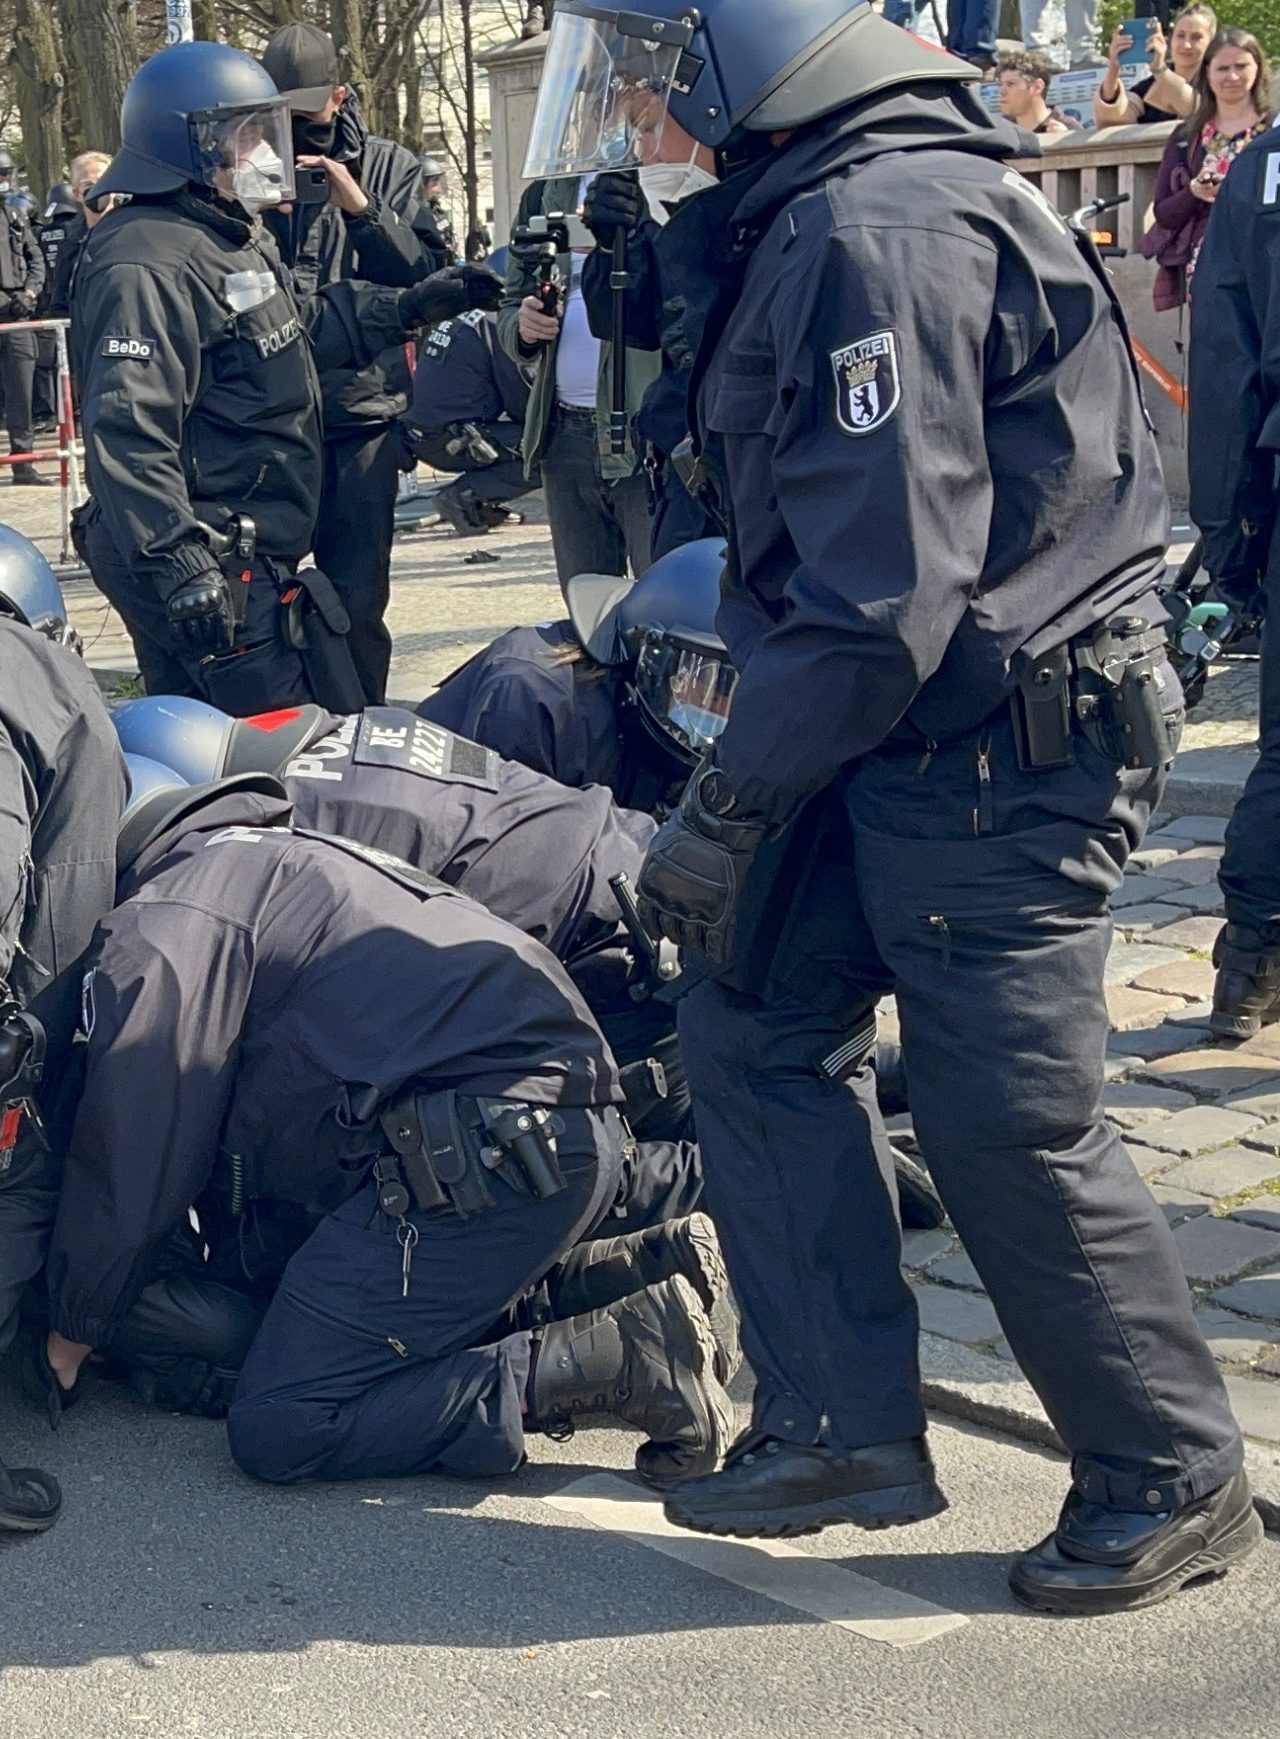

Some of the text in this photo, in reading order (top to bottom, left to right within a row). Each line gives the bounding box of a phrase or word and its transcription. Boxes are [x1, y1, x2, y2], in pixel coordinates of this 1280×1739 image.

[109, 340, 150, 356] BeDo
[835, 338, 889, 371] POLIZEI
[369, 727, 407, 748] BE
